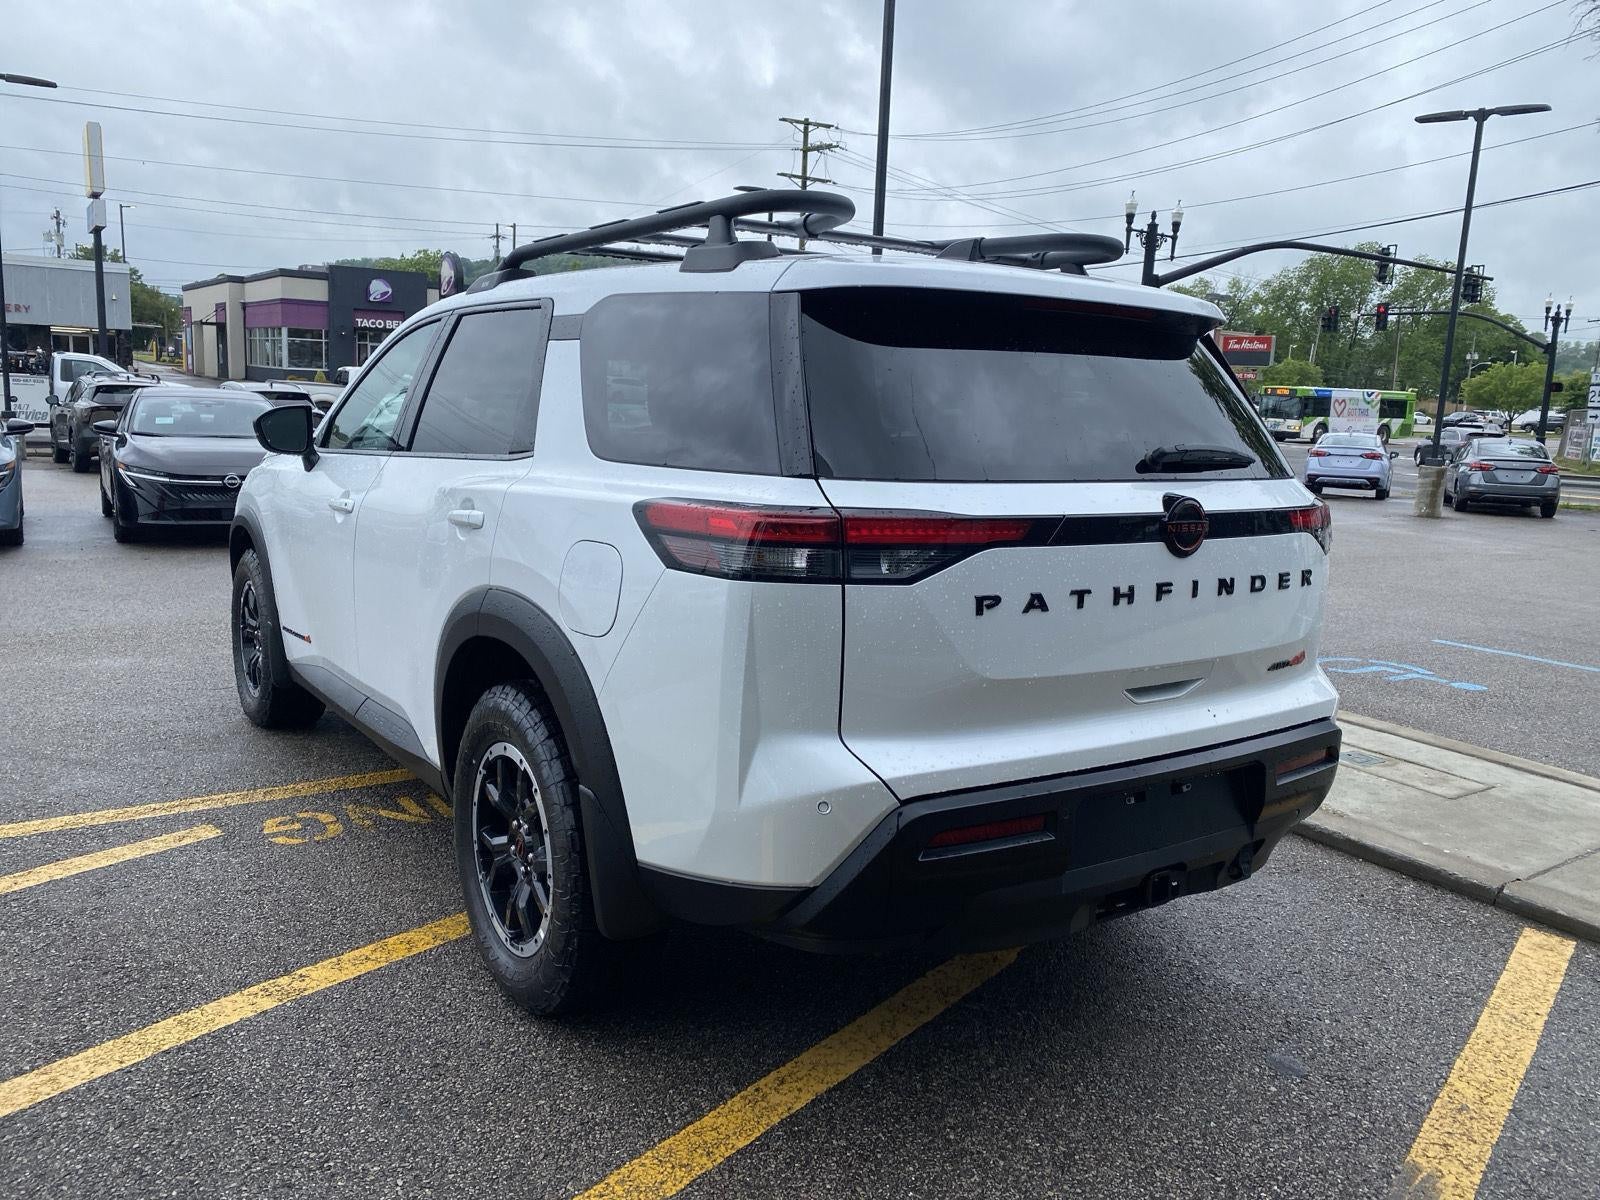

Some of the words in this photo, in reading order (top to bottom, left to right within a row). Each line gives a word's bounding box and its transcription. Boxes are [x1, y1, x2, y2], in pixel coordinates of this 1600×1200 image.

[355, 318, 384, 328] TACO
[1228, 339, 1241, 350] Tim
[1240, 339, 1268, 350] Hortons
[974, 568, 1314, 617] PATHFINDER
